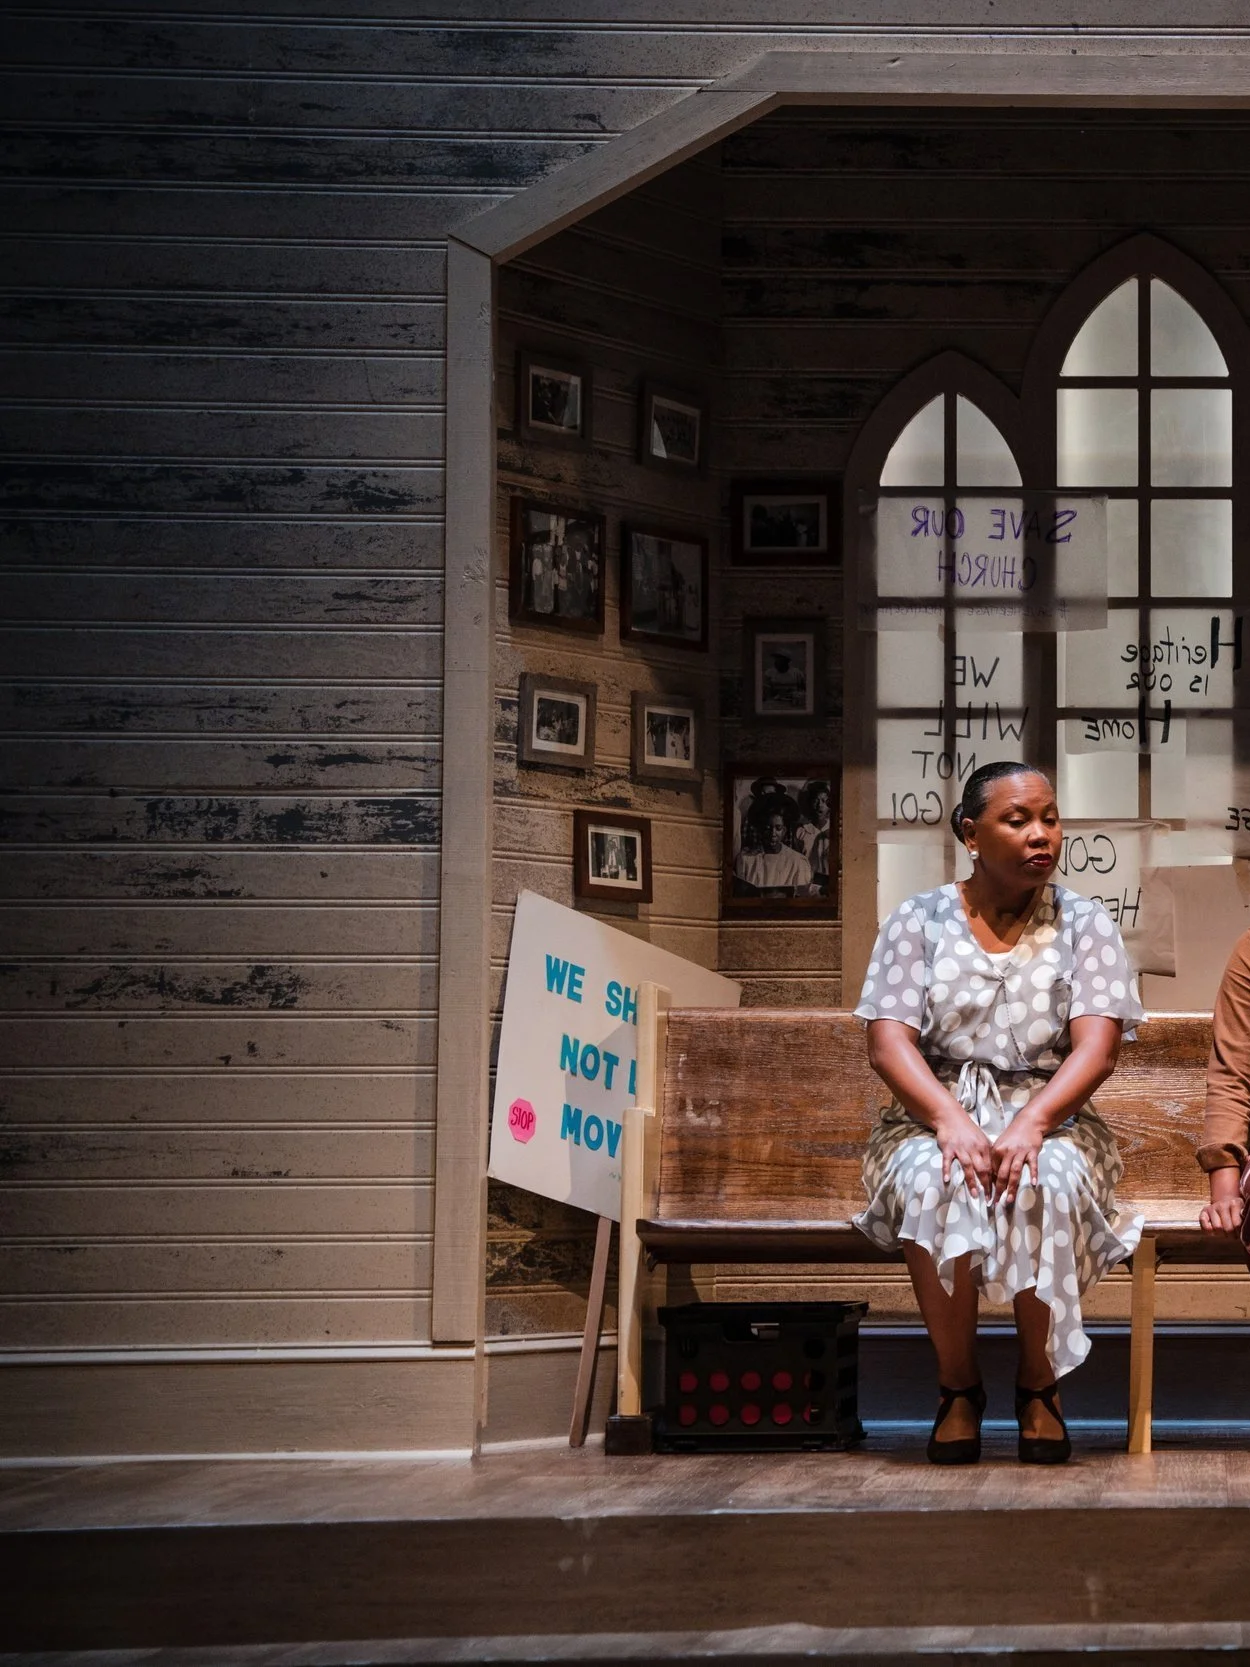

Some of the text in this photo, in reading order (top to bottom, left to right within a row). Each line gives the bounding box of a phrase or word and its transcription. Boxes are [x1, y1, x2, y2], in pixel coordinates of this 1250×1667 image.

[545, 953, 638, 1026] WE SH
[559, 1033, 619, 1090] NOT
[511, 1106, 533, 1130] STOP
[560, 1103, 623, 1159] MOV
